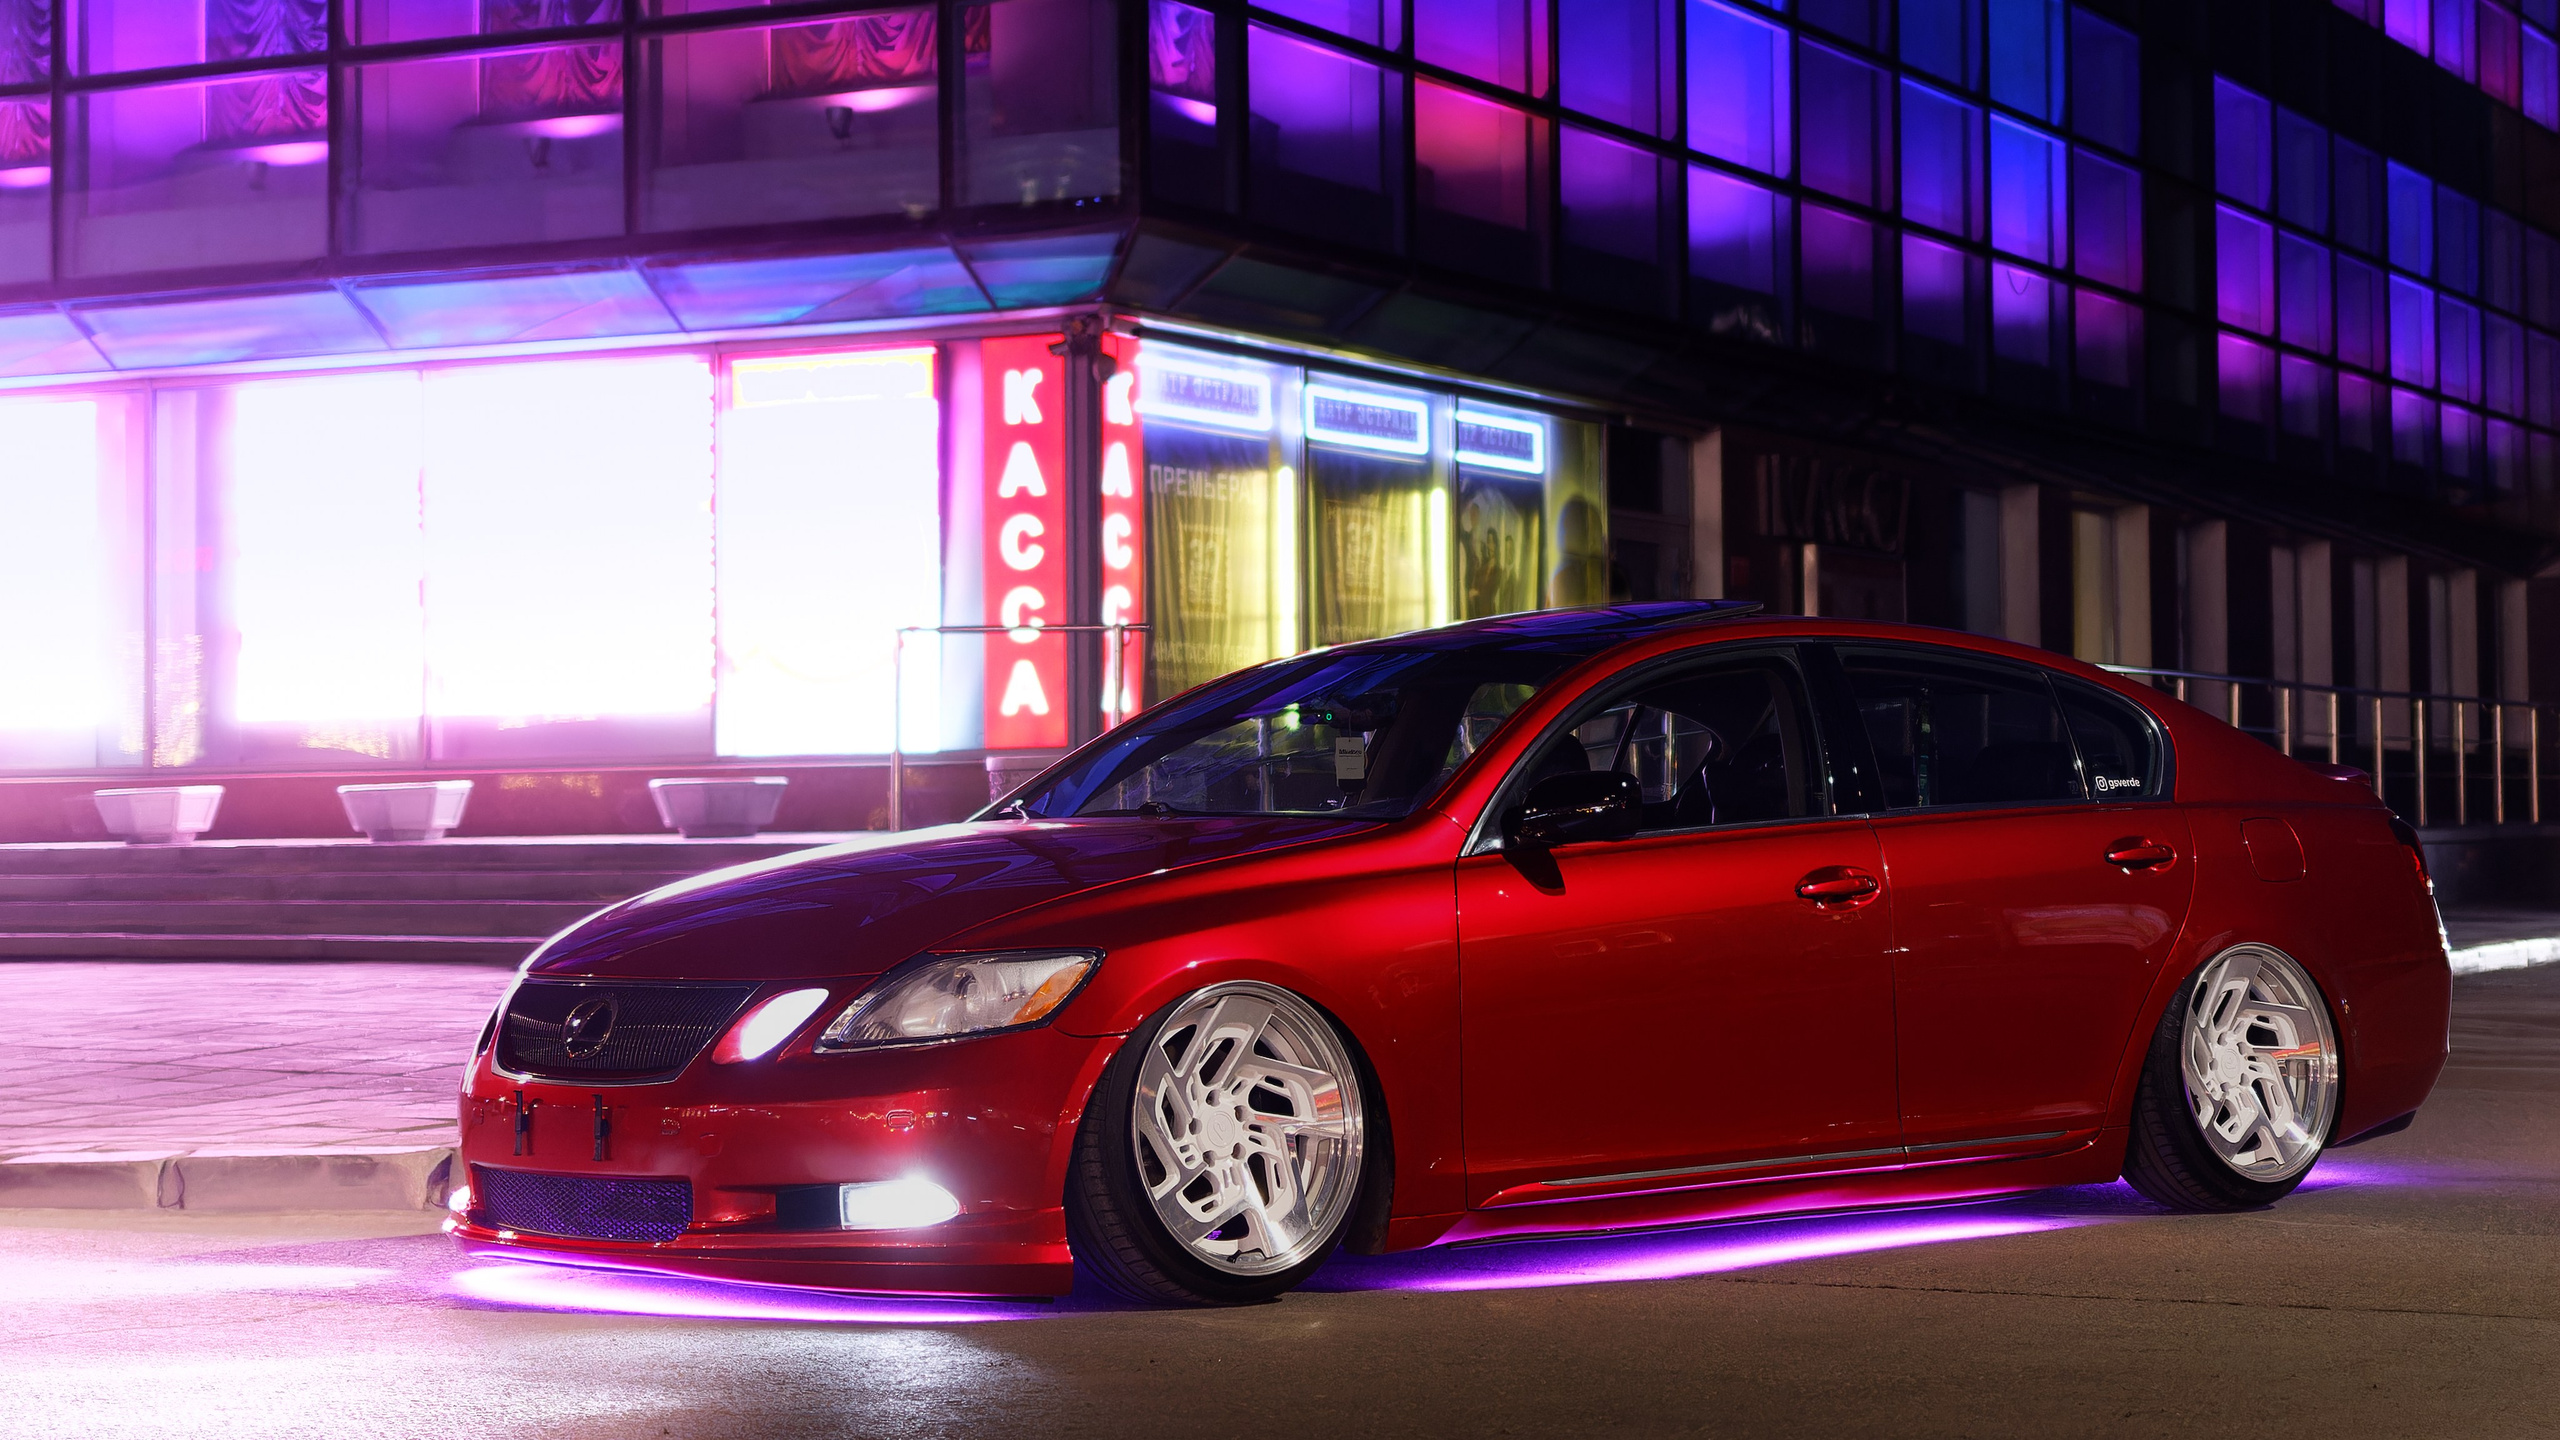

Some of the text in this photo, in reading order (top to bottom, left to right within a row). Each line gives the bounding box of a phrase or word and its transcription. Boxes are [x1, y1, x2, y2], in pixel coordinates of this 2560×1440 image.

[1149, 464, 1251, 504] ПРЕМЬЕРА
[998, 367, 1050, 717] КАССА
[2108, 777, 2140, 789] gsverde
